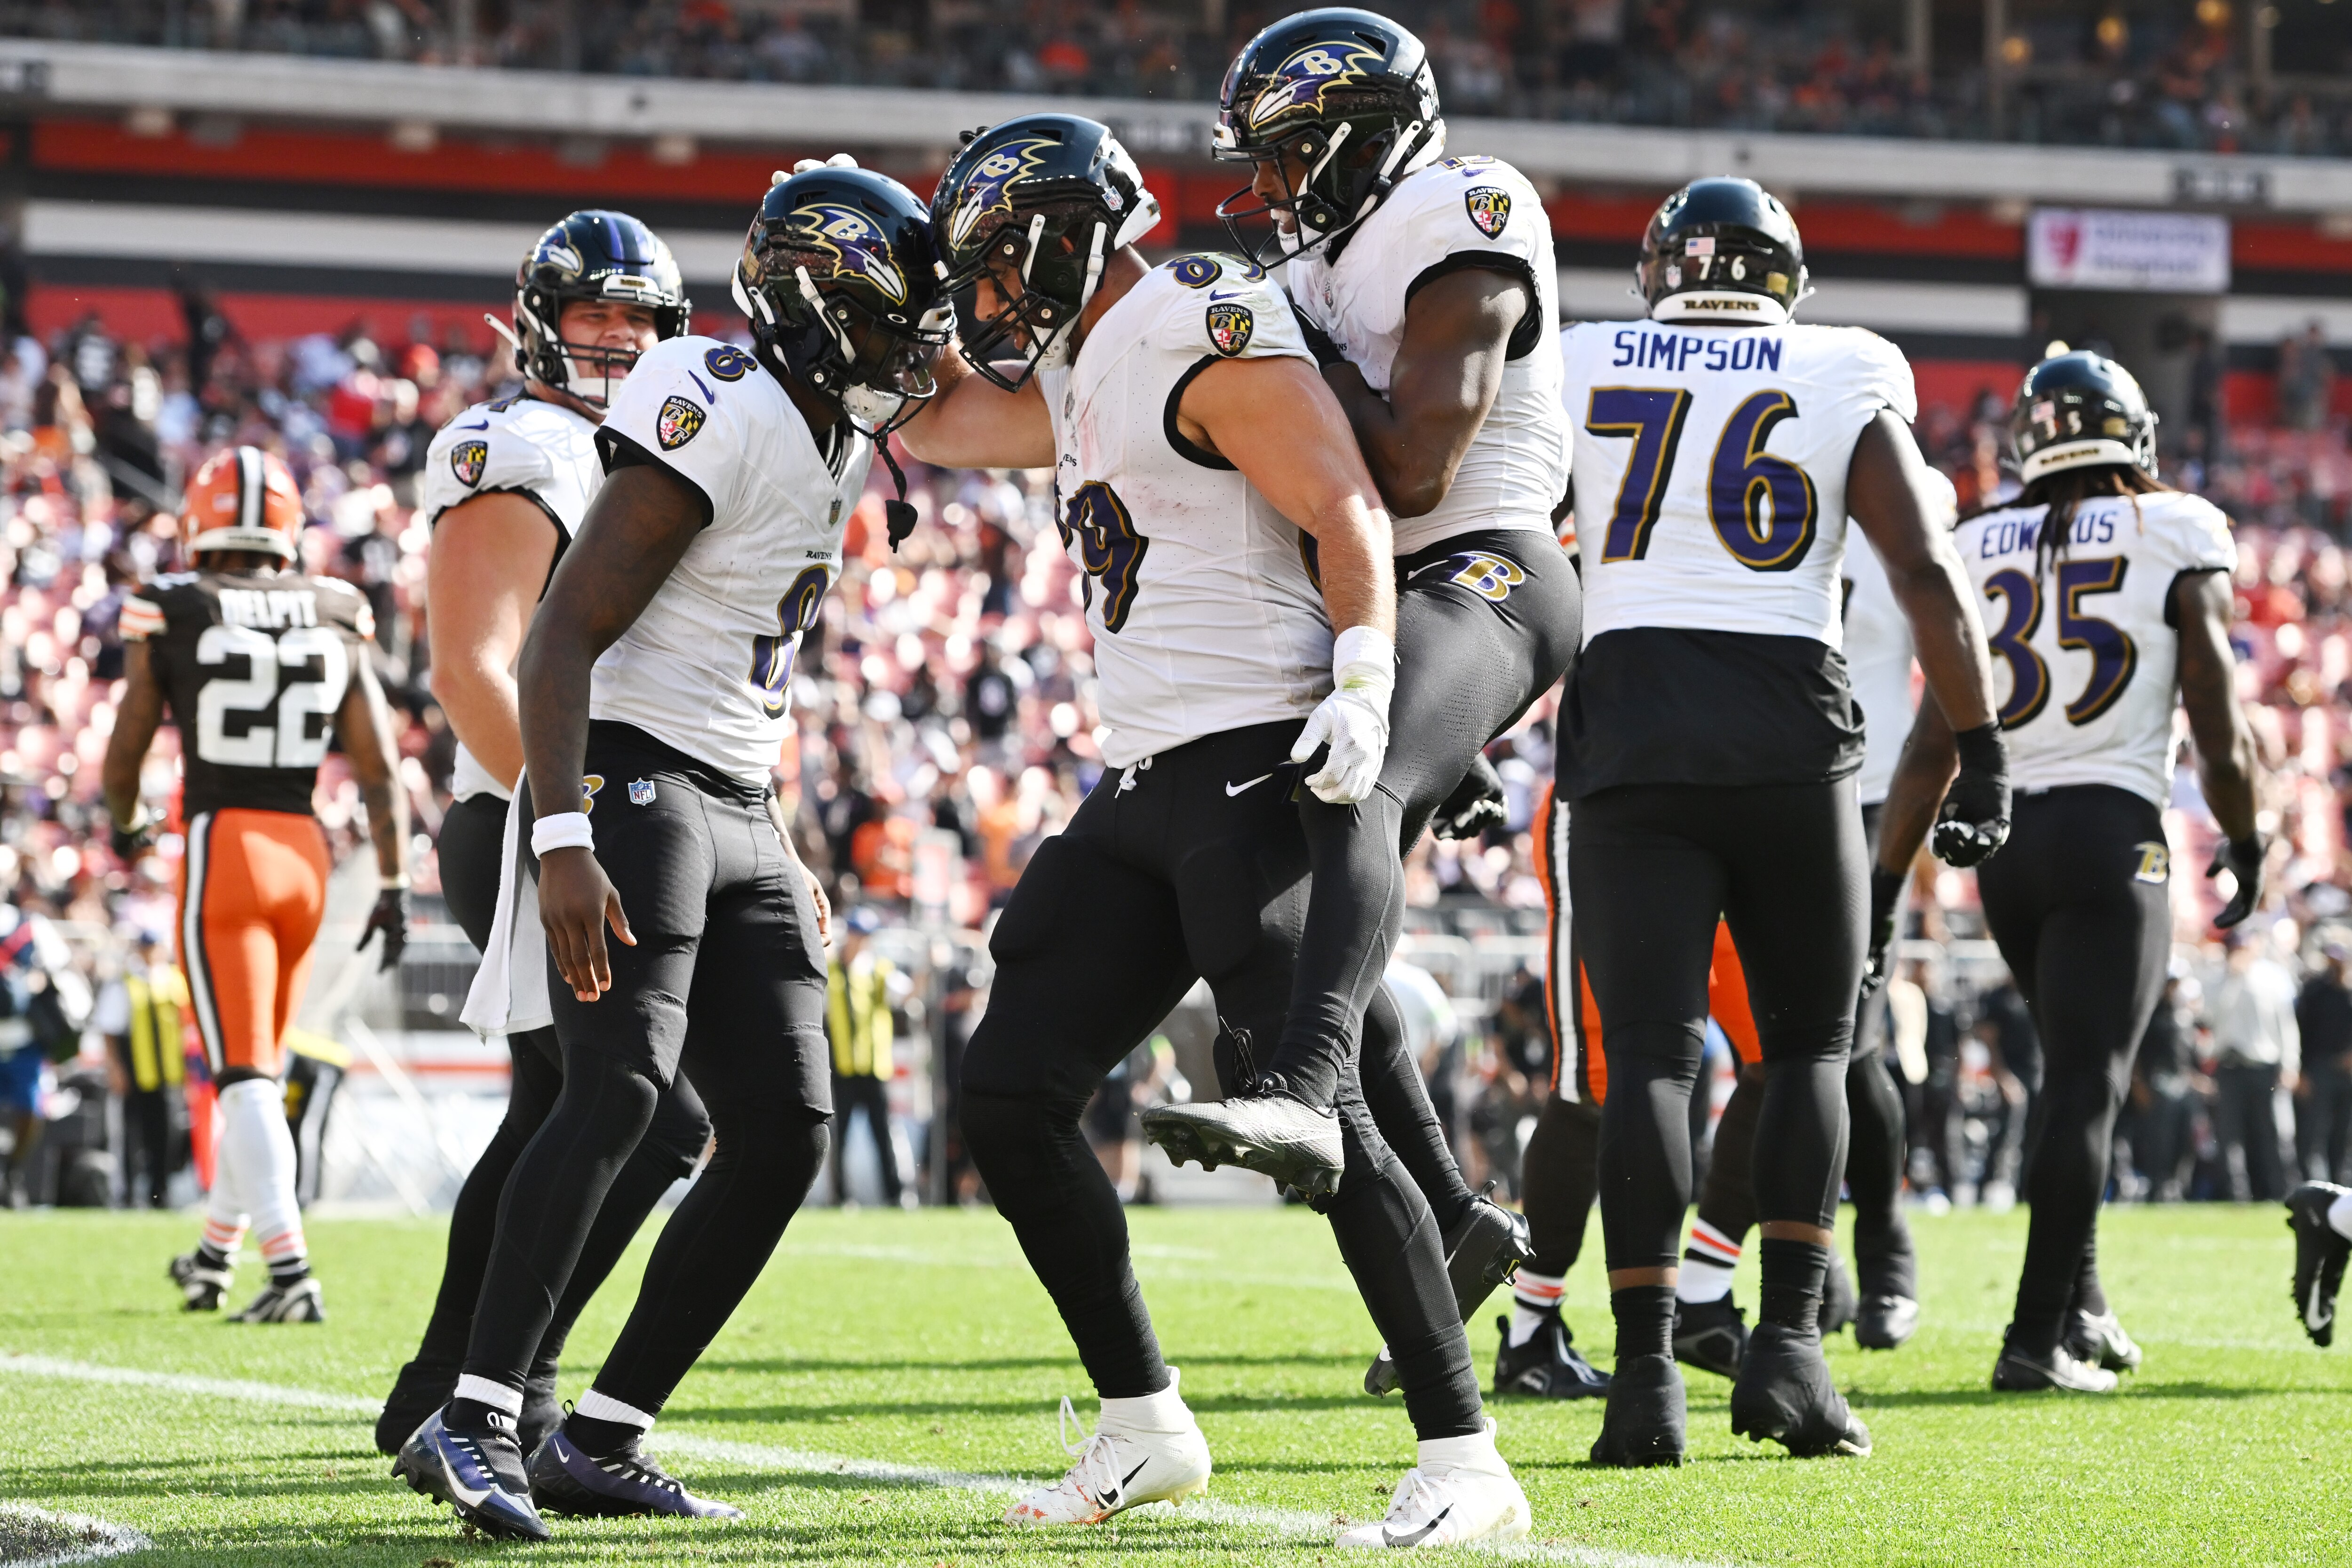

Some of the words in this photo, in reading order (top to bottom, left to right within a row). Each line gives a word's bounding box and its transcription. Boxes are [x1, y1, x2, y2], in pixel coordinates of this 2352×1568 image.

[1468, 188, 1506, 196] RAVENS
[1210, 306, 1248, 316] RAVENS
[1684, 300, 1759, 310] RAVENS
[703, 345, 757, 382] 8
[1613, 331, 1782, 371] SIMPSON
[670, 397, 703, 419] RAVENS
[1586, 386, 1817, 572] 76
[1981, 510, 2119, 559] EDWDS
[806, 550, 832, 560] RAVENS
[1983, 554, 2138, 731] 35
[197, 624, 348, 768] 22
[633, 789, 653, 801] NFL
